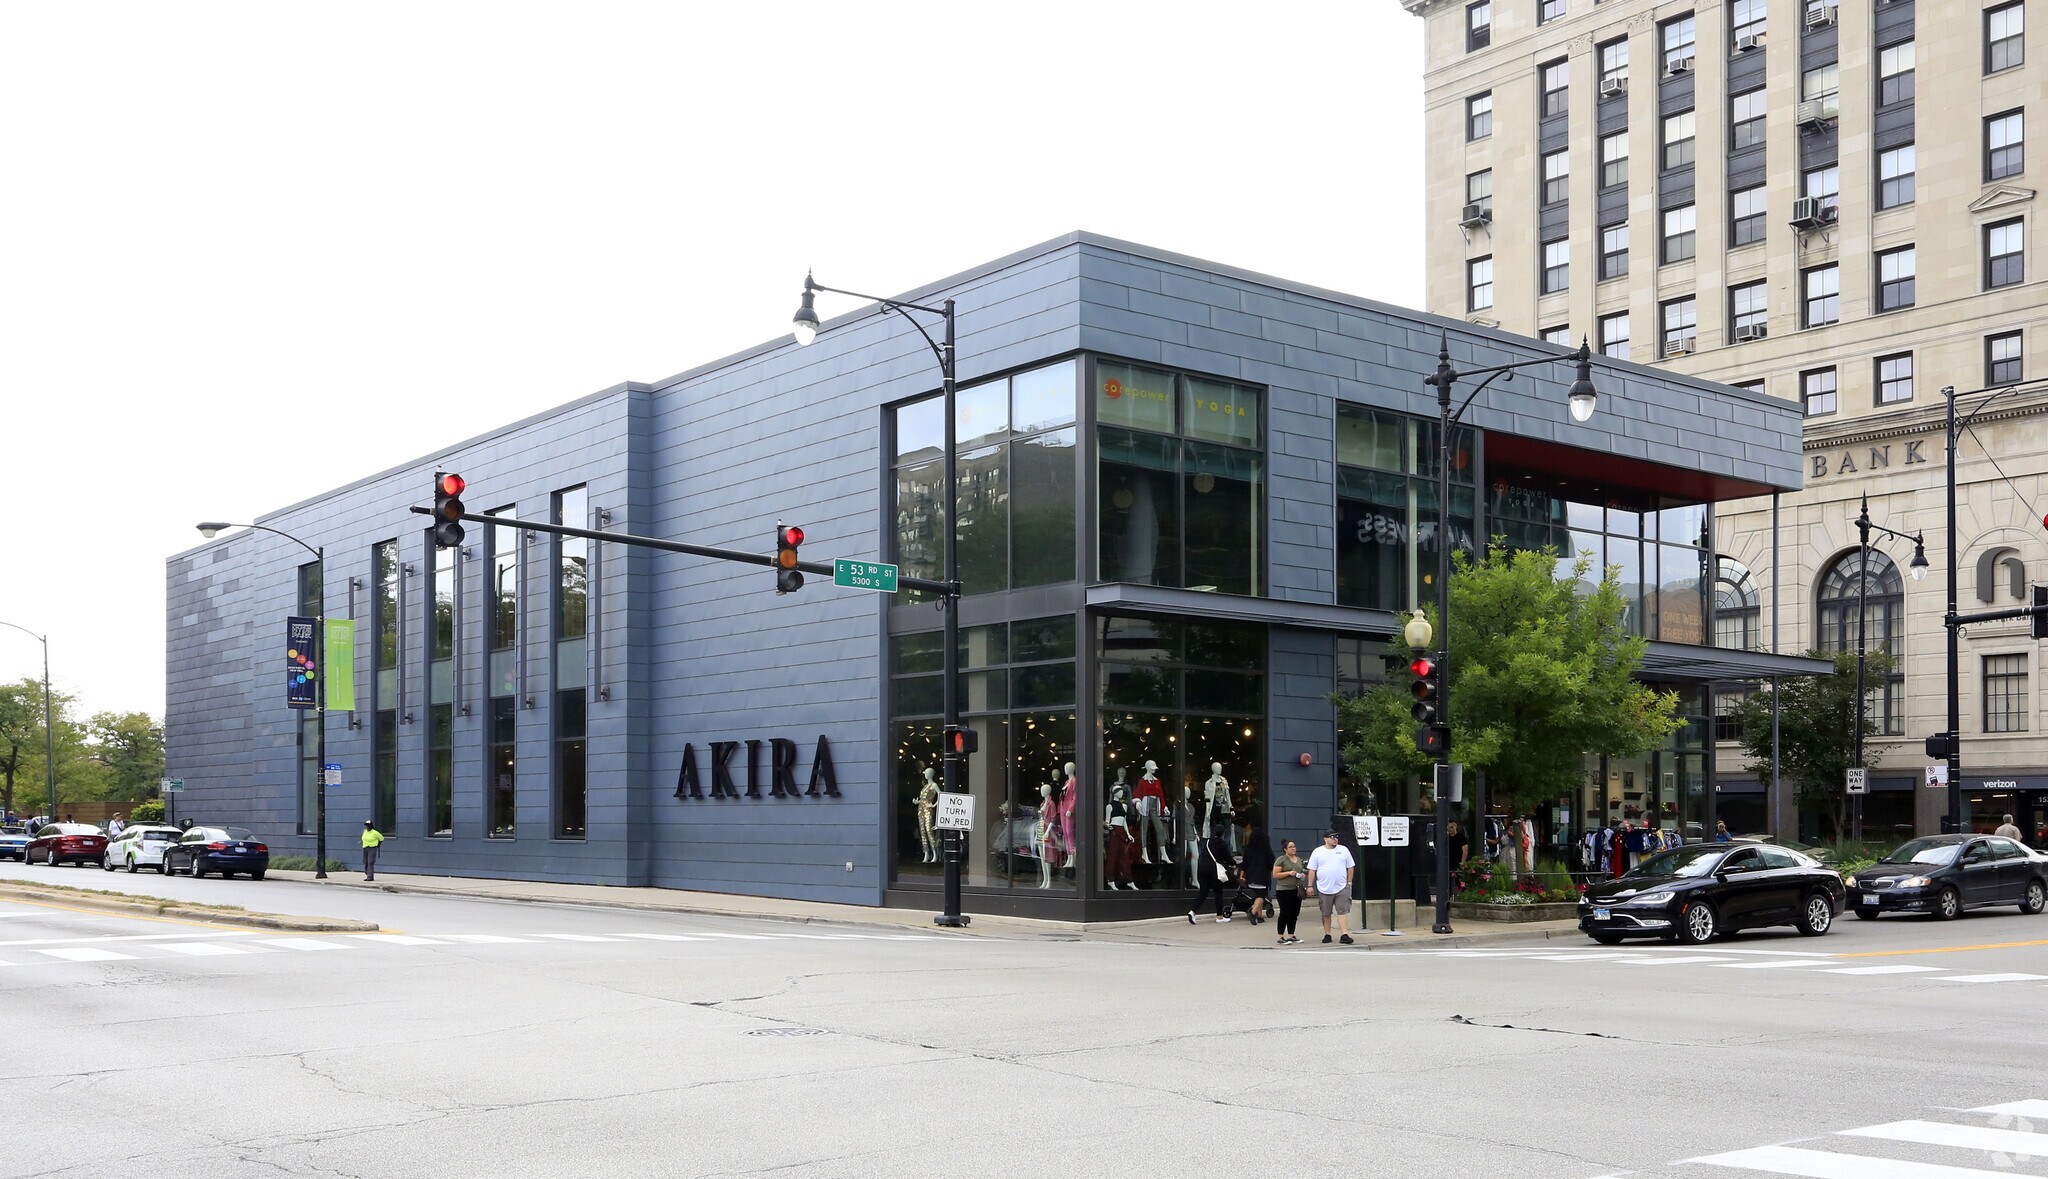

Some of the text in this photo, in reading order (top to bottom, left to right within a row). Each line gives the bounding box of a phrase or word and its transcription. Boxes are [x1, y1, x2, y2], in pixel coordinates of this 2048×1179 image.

[1103, 383, 1246, 417] corepower YOGA
[1811, 439, 1926, 478] BANK
[839, 564, 844, 572] E
[884, 569, 893, 577] ST
[852, 576, 880, 587] 5300 S
[1663, 611, 1681, 624] ONE
[1662, 627, 1683, 640] FREE
[673, 734, 842, 798] AKIRA
[1983, 779, 2017, 788] verizon
[949, 798, 963, 806] NO
[945, 807, 967, 815] TURN
[940, 816, 970, 826] ON RED
